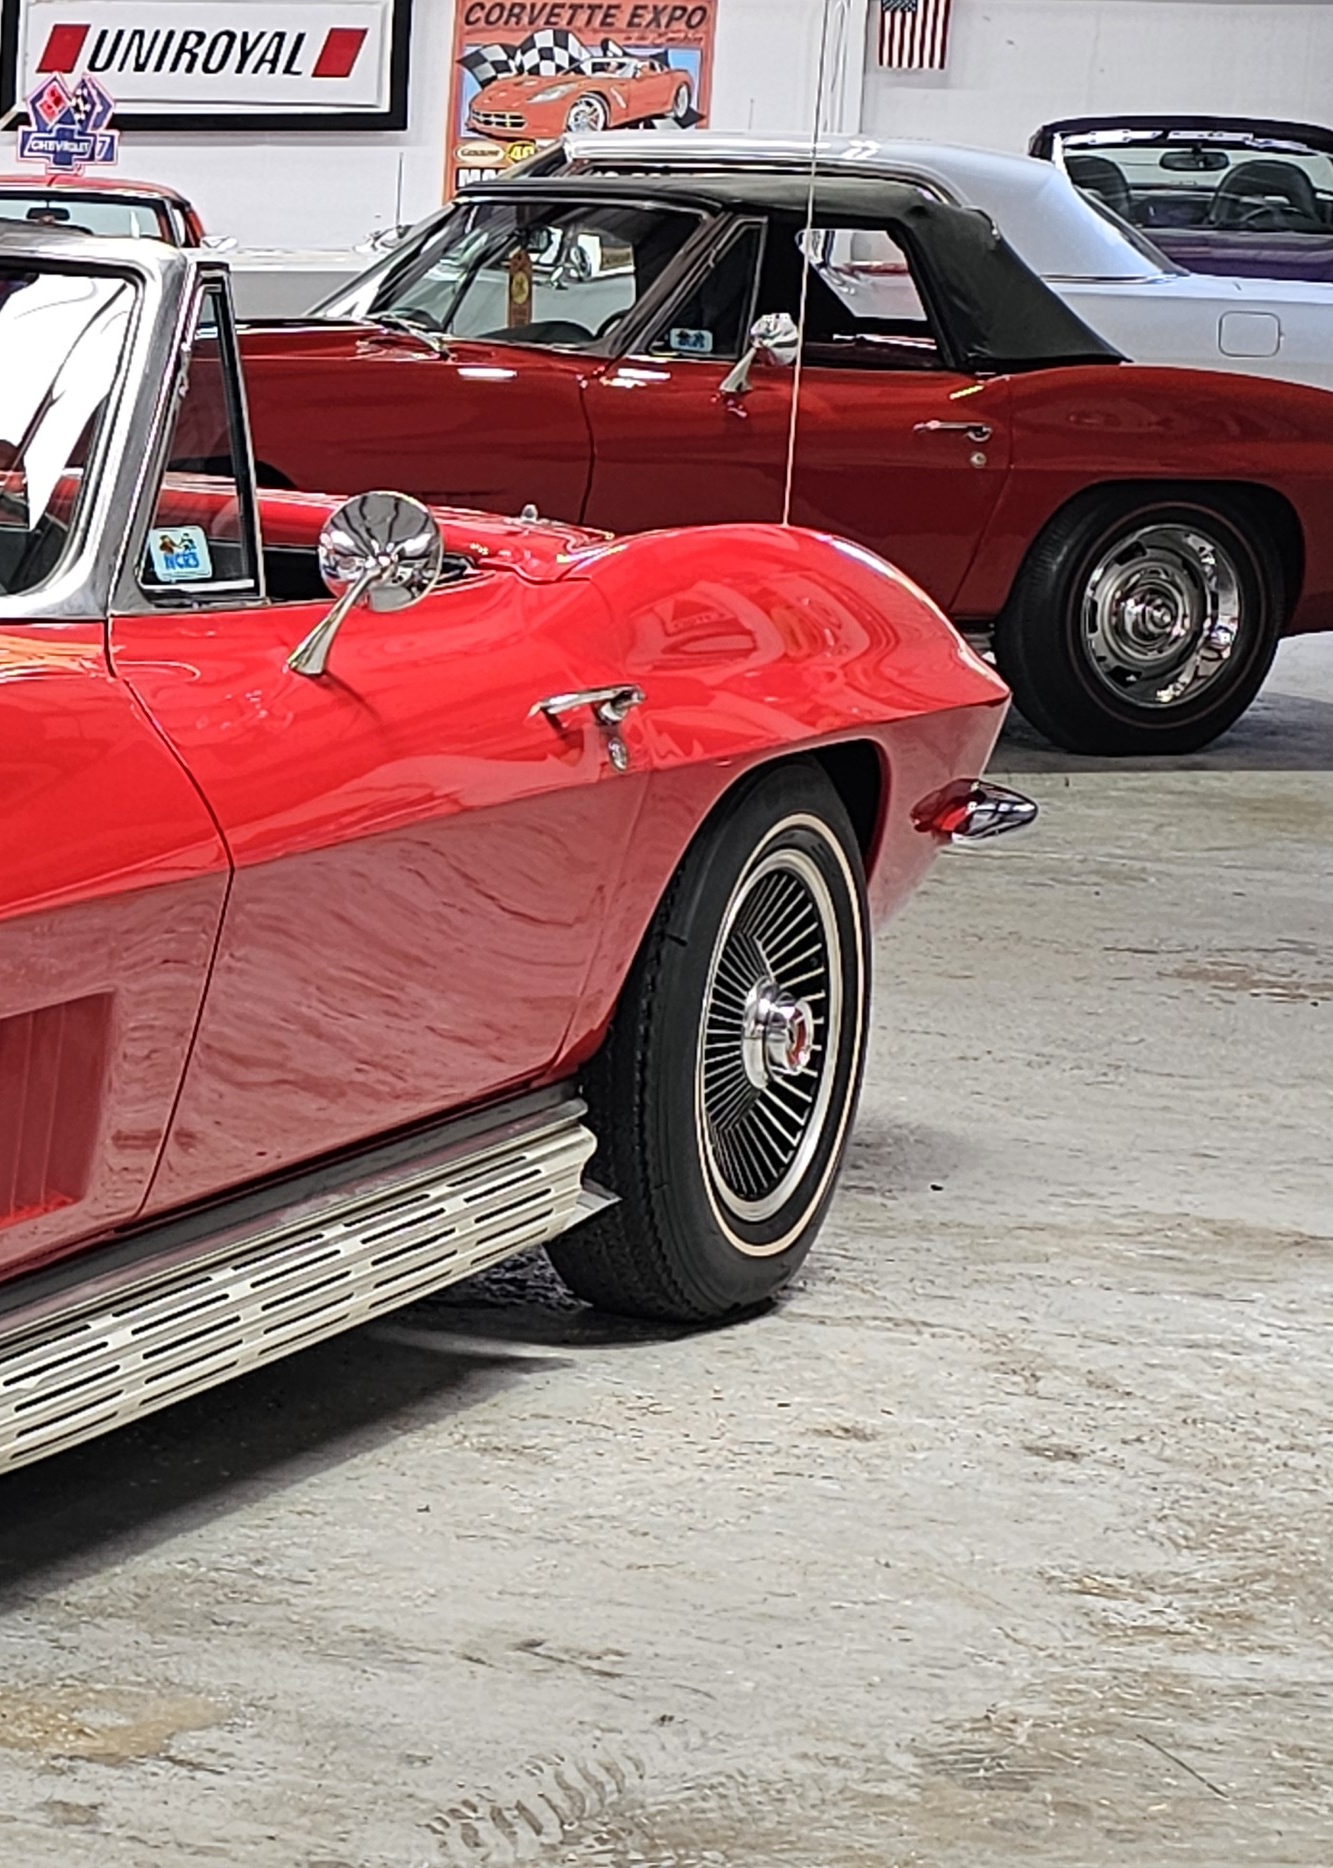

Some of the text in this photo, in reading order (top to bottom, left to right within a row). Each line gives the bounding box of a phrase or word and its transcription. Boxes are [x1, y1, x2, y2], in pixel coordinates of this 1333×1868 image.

[464, 2, 708, 30] CORVETTE EXPO
[87, 29, 306, 75] UNIROYAL
